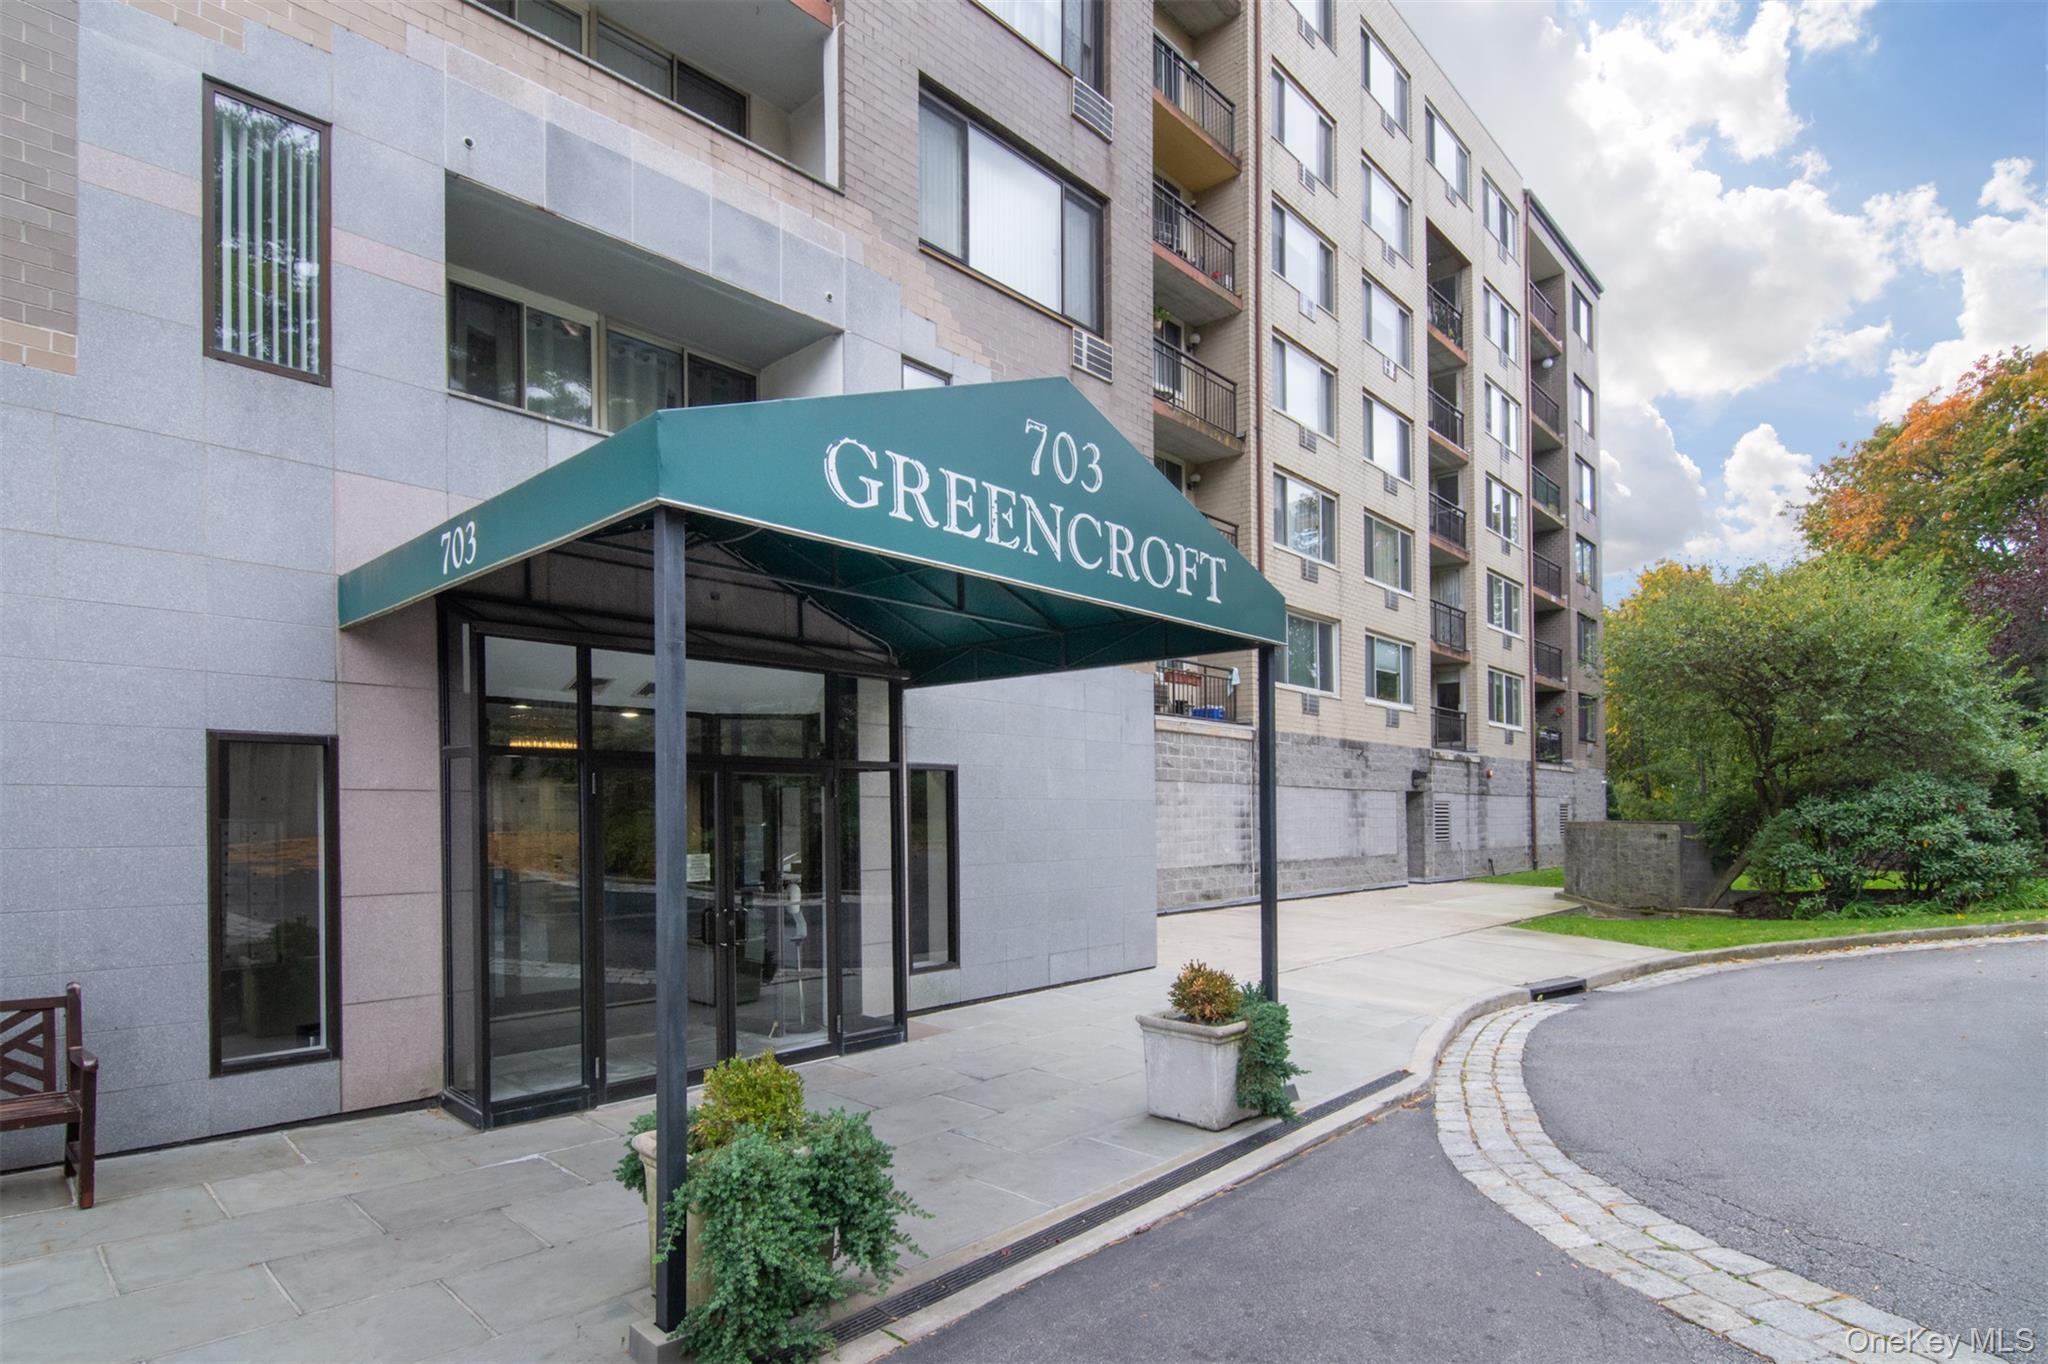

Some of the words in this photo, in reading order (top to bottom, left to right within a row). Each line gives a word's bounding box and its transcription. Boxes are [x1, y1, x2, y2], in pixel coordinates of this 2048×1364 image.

[1025, 418, 1103, 494] 703
[440, 520, 477, 575] 703
[823, 436, 1227, 604] GREENCROFT
